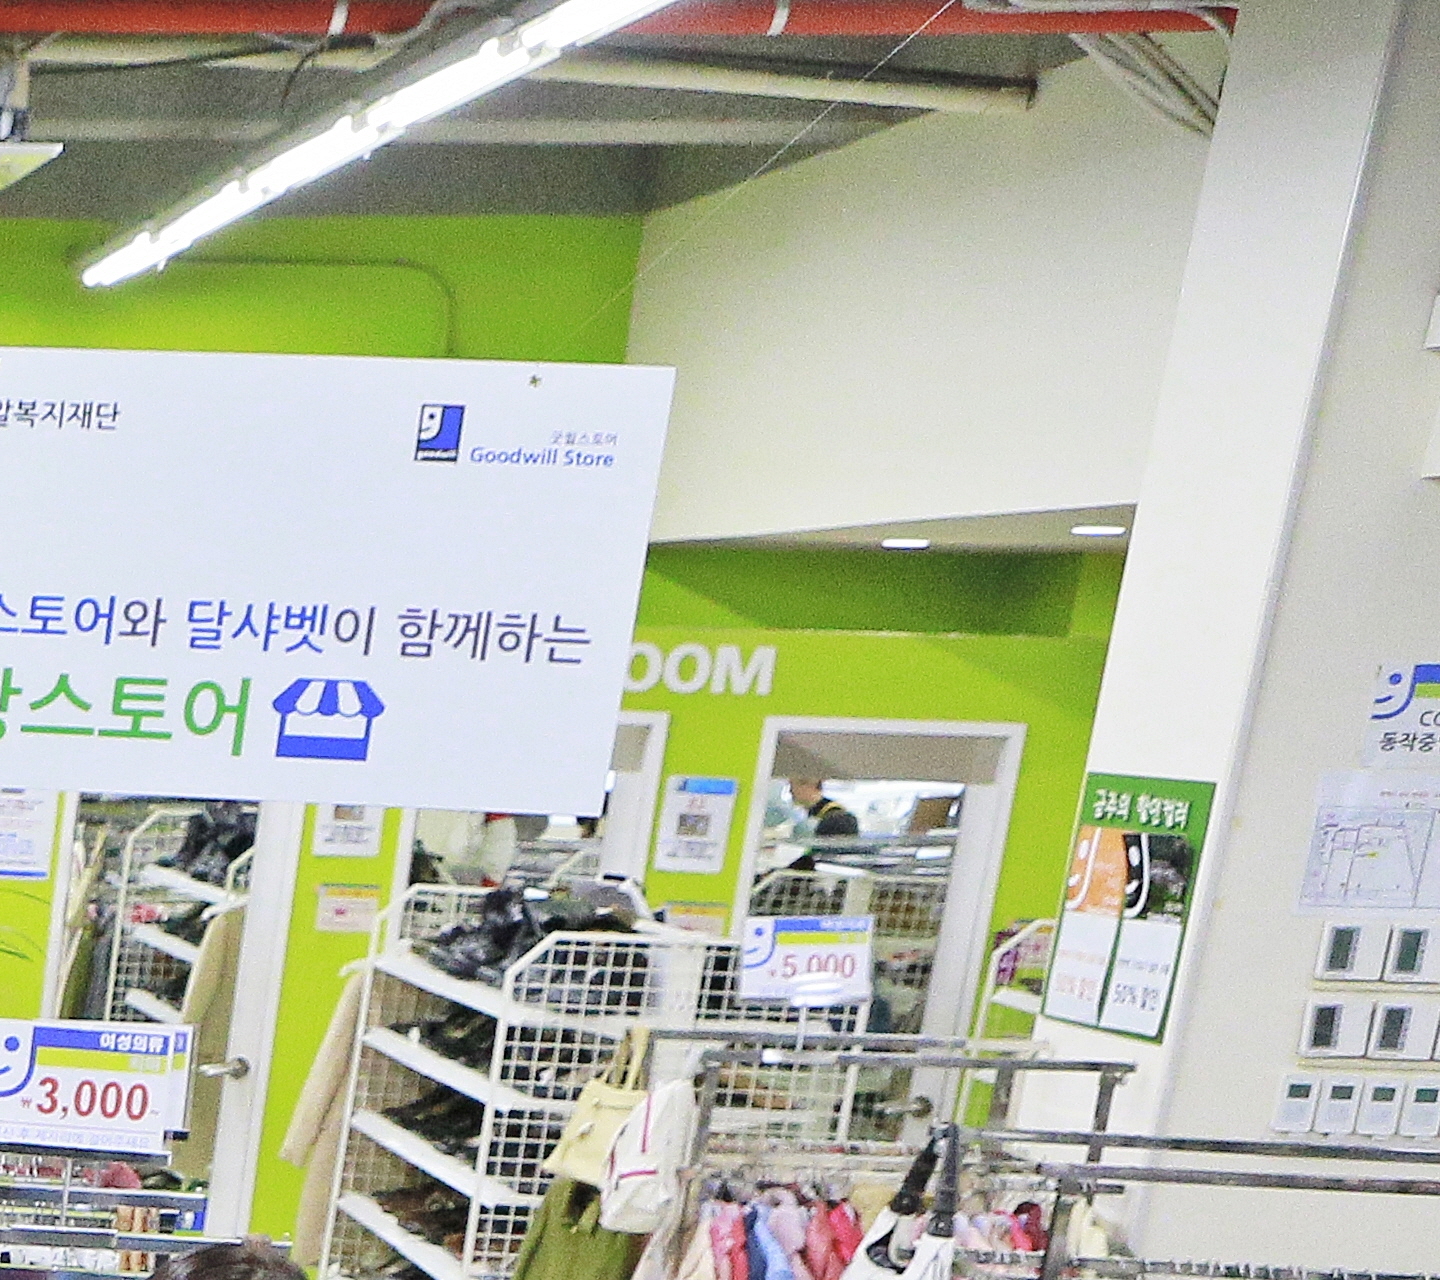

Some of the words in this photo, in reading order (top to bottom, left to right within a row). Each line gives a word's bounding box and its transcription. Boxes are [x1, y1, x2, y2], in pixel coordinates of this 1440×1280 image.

[469, 446, 558, 465] Goodwill
[563, 451, 616, 468] Store
[186, 599, 377, 657] 달샤벳이
[397, 607, 592, 665] 함께하는
[1379, 732, 1440, 752] 동작중
[99, 1033, 164, 1054] 여성의류
